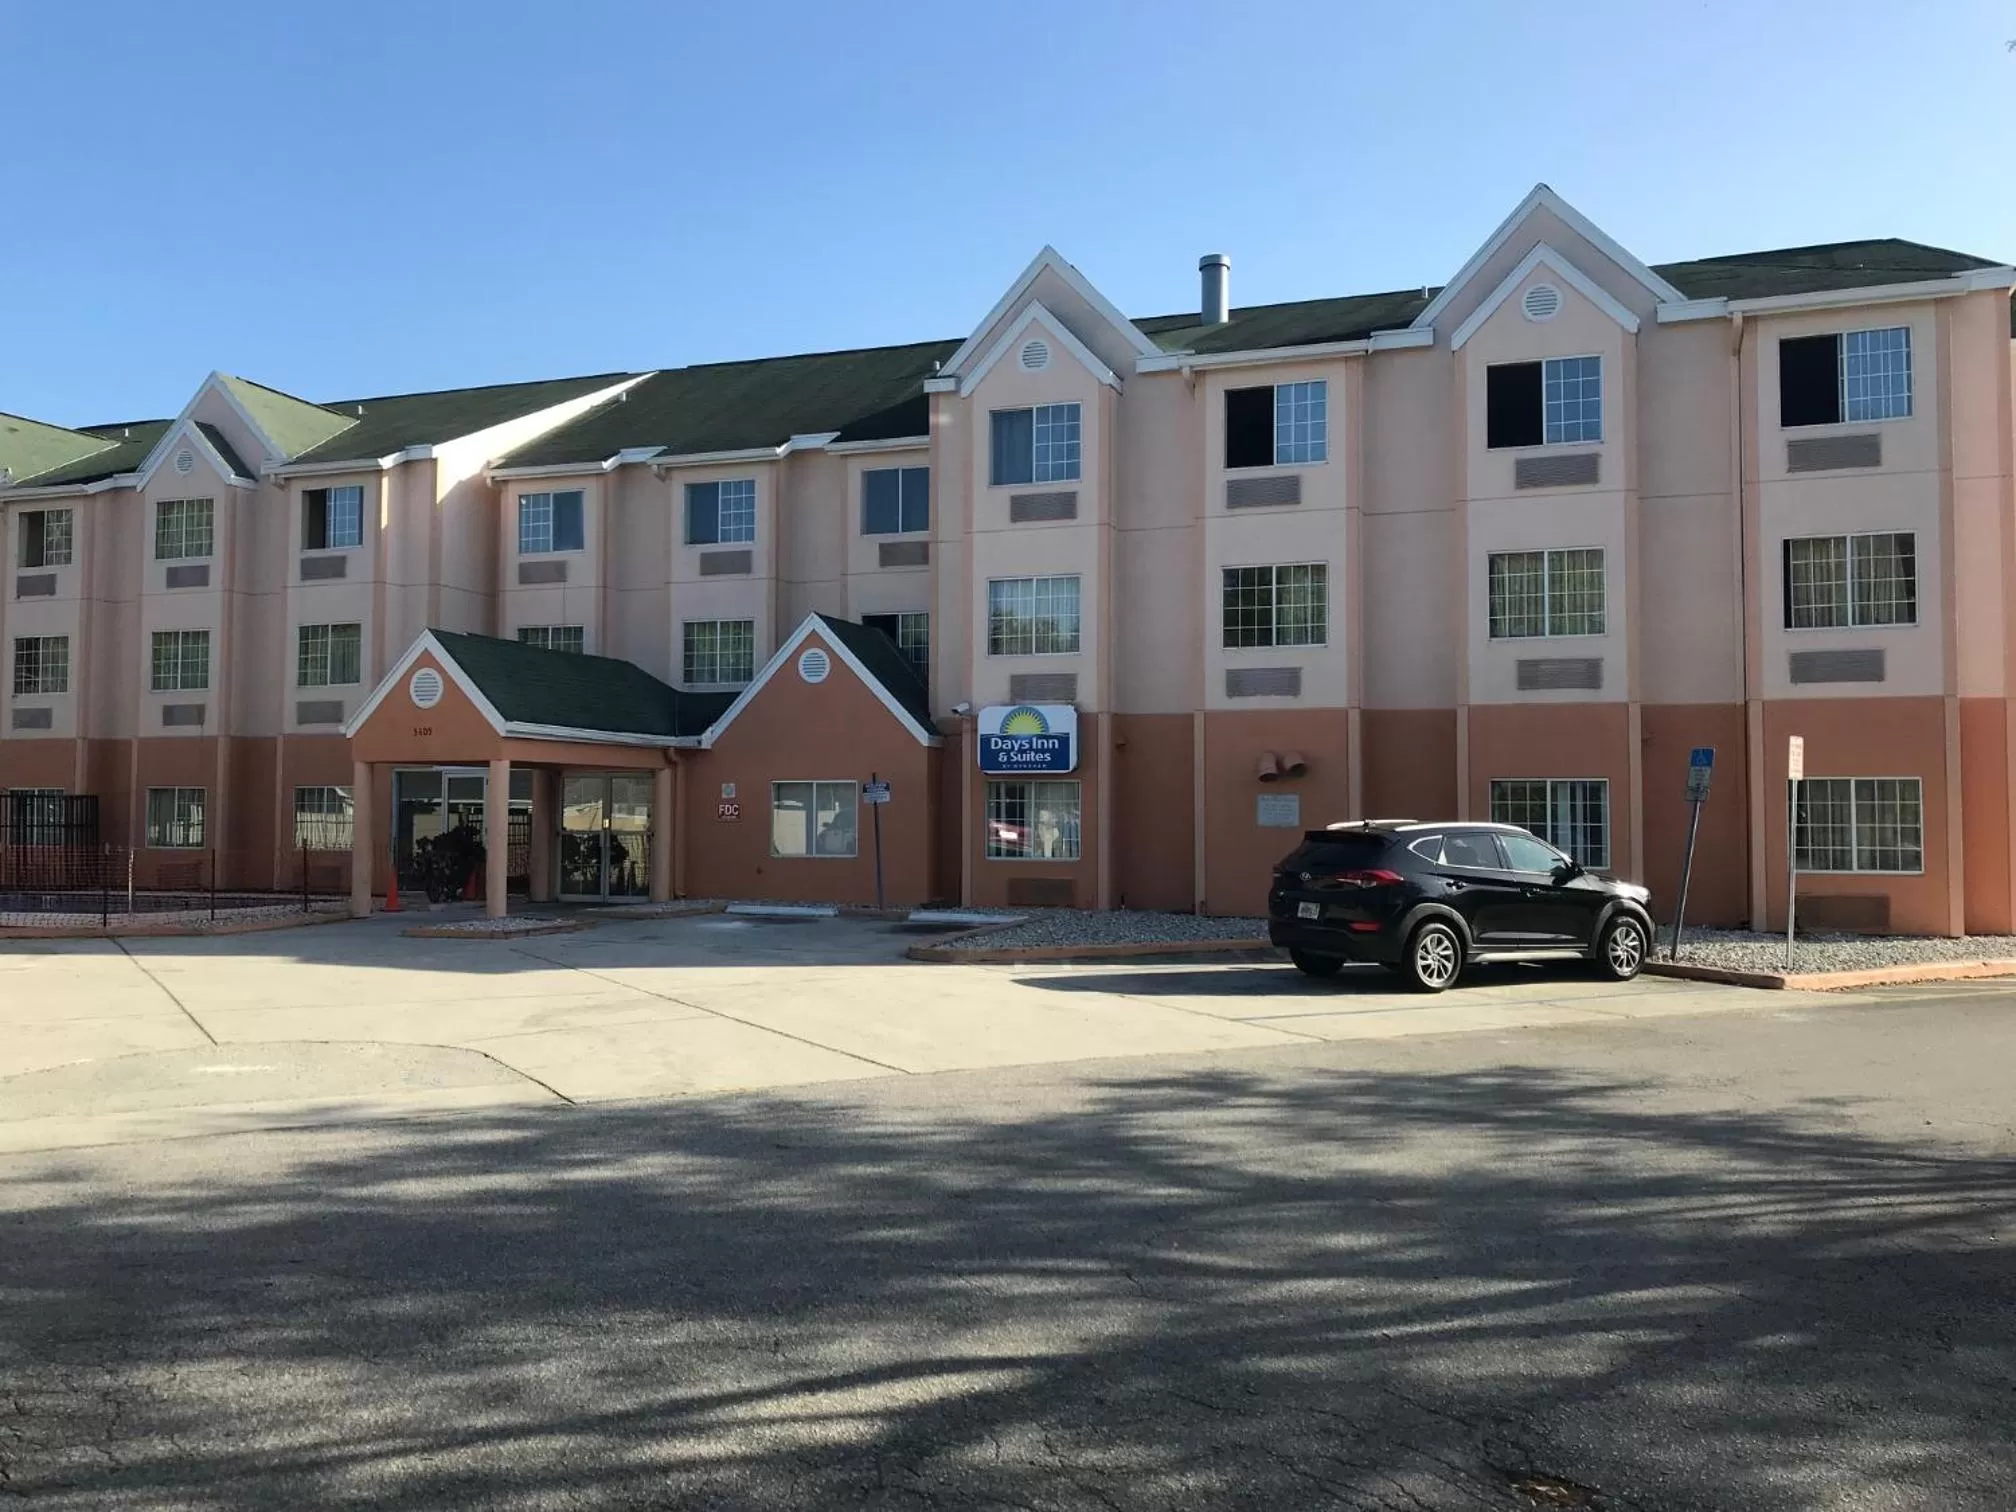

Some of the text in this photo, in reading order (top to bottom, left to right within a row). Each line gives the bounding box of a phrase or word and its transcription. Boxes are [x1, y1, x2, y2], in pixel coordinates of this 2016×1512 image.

[991, 737, 1059, 751] Days Inn
[998, 750, 1051, 762] & Suites
[718, 804, 739, 816] FDC
